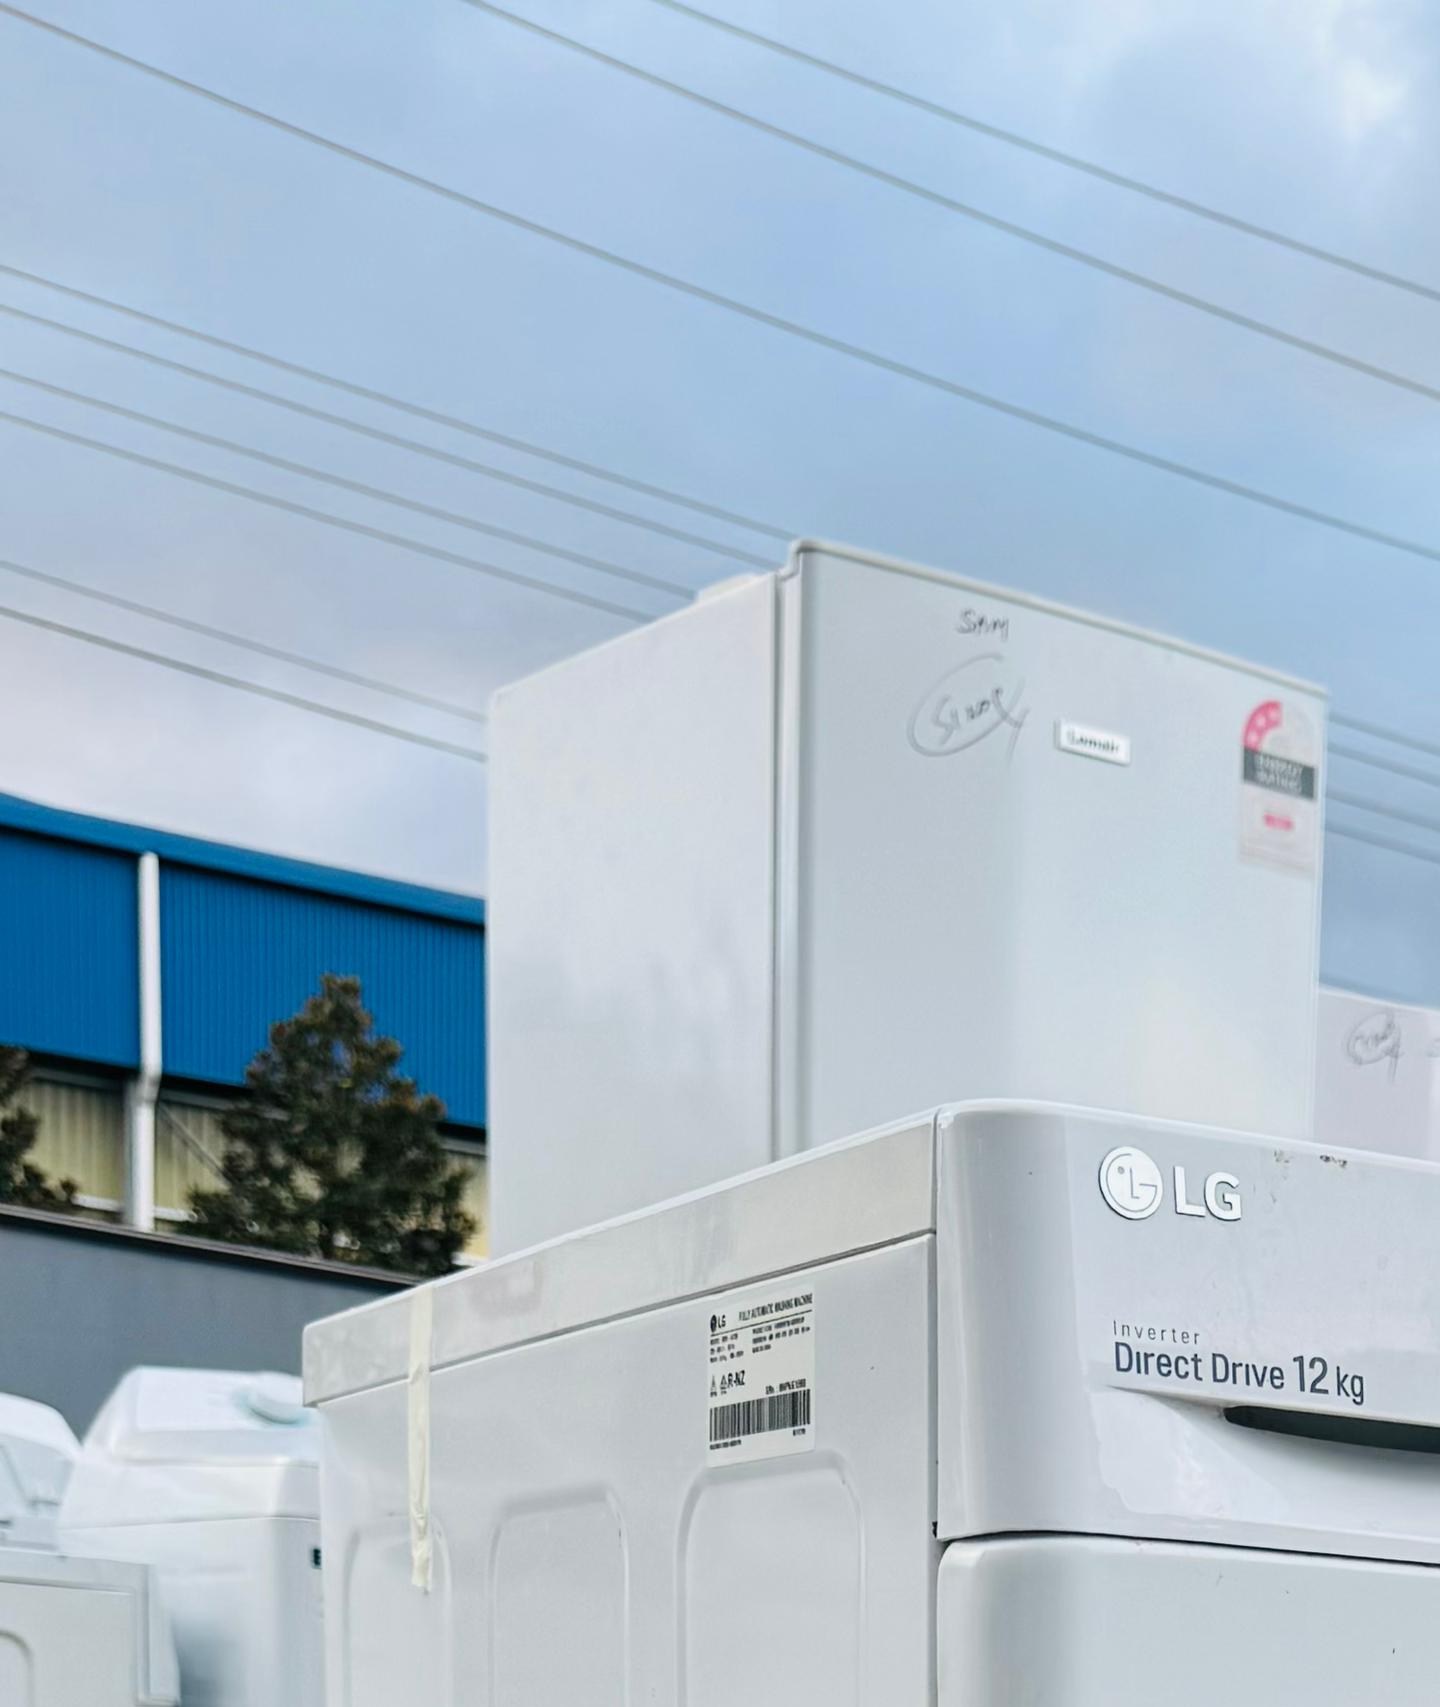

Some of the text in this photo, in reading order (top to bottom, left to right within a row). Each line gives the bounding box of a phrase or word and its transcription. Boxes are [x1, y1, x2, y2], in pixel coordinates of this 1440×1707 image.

[1173, 1166, 1242, 1222] LG
[1113, 1320, 1200, 1344] Inverter
[1115, 1341, 1365, 1406] Direct Drive 12 kg
